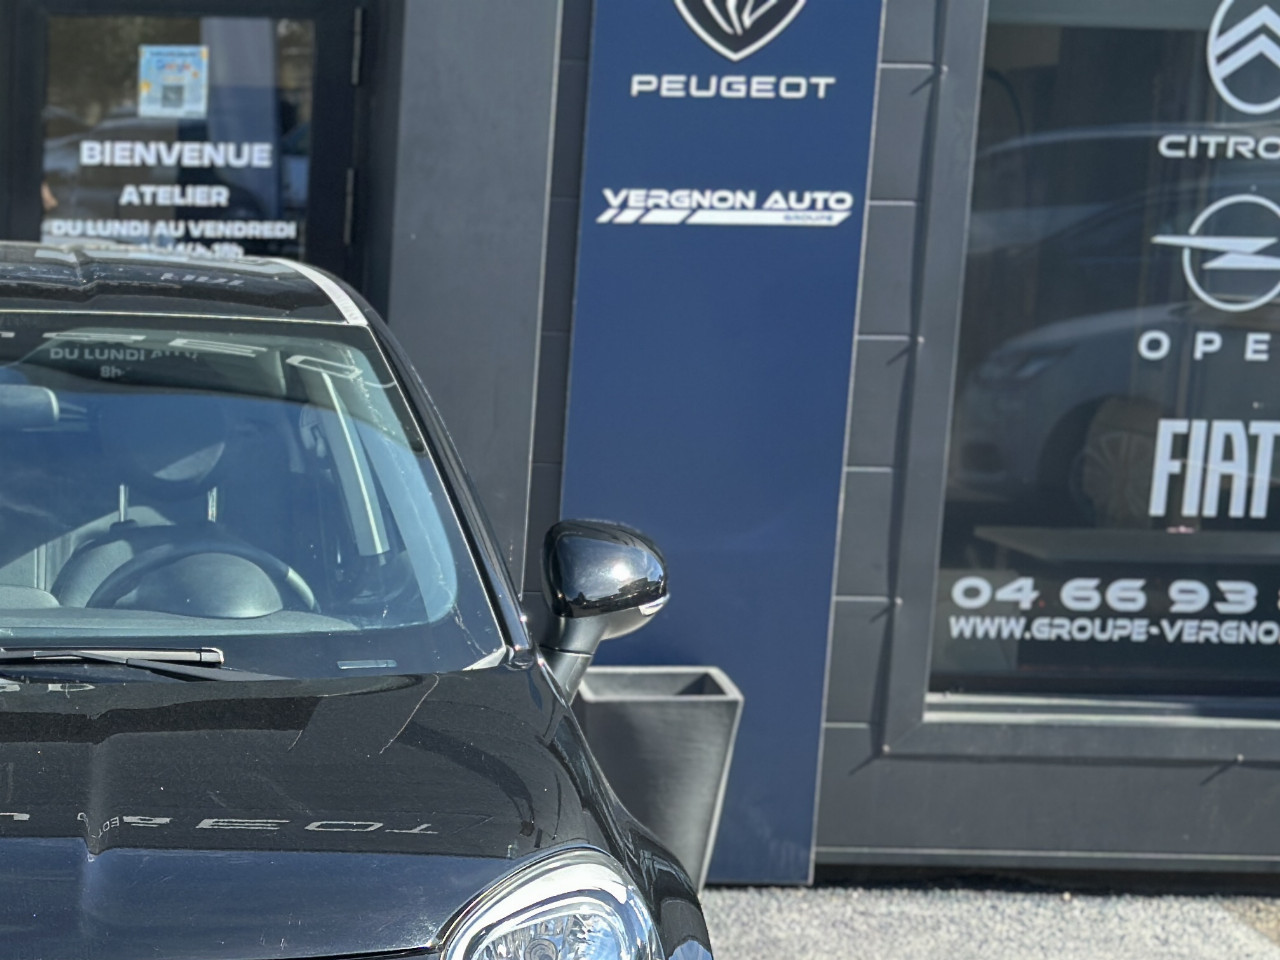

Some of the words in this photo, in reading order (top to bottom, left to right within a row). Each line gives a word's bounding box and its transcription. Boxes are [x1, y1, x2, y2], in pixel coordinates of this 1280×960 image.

[630, 74, 836, 99] PEUGEOT
[79, 140, 273, 168] BIENVENUE
[119, 184, 230, 207] ATELIER
[602, 188, 756, 210] VERGNON
[761, 190, 854, 211] AUTO
[51, 219, 81, 236] DU
[85, 219, 150, 237] LUNDI
[152, 219, 185, 238] AU
[186, 220, 297, 239] VENDREDI
[1148, 418, 1280, 519] FIAT
[951, 576, 1041, 611] 04
[1059, 577, 1148, 612] 66
[1168, 578, 1259, 614] 93
[948, 615, 1280, 645] WWW.GROUPE-VERGNO
